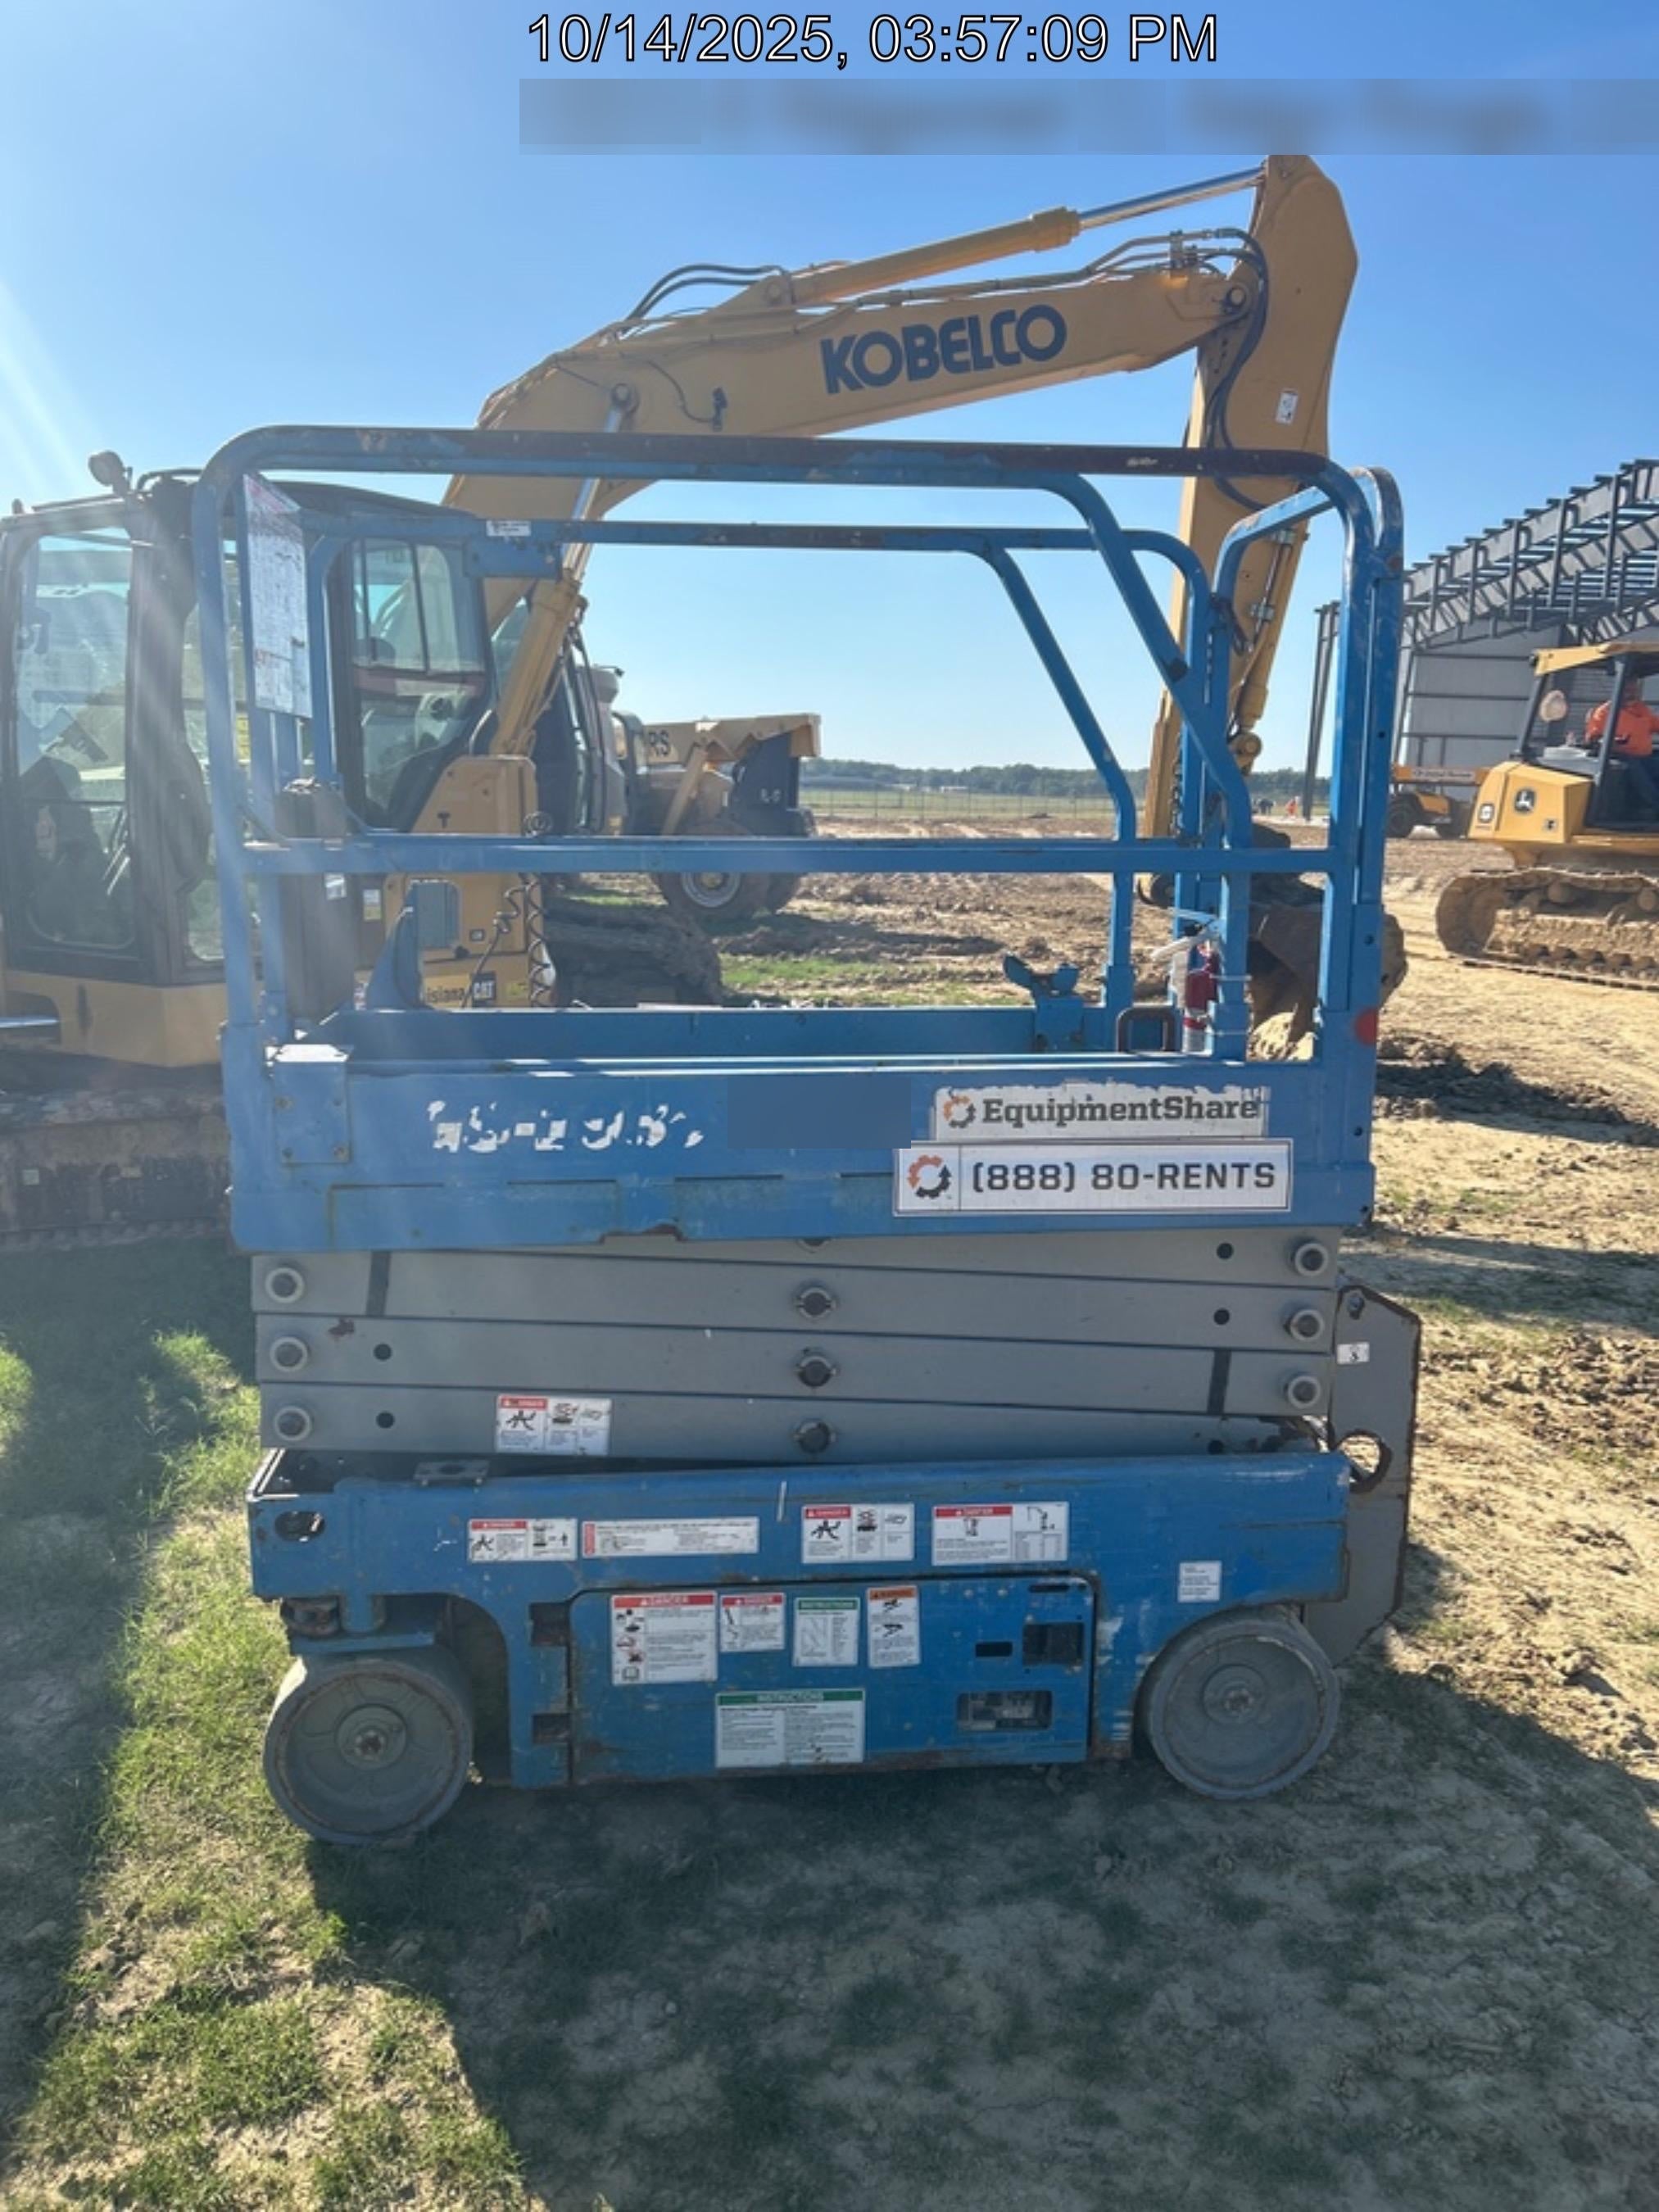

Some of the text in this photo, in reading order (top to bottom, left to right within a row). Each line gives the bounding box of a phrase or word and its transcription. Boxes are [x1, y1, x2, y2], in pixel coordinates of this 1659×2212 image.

[820, 304, 1067, 395] KOBELCO
[981, 1095, 1258, 1129] EquipmentShare
[972, 1161, 1276, 1193] (888) 80-RENTS
